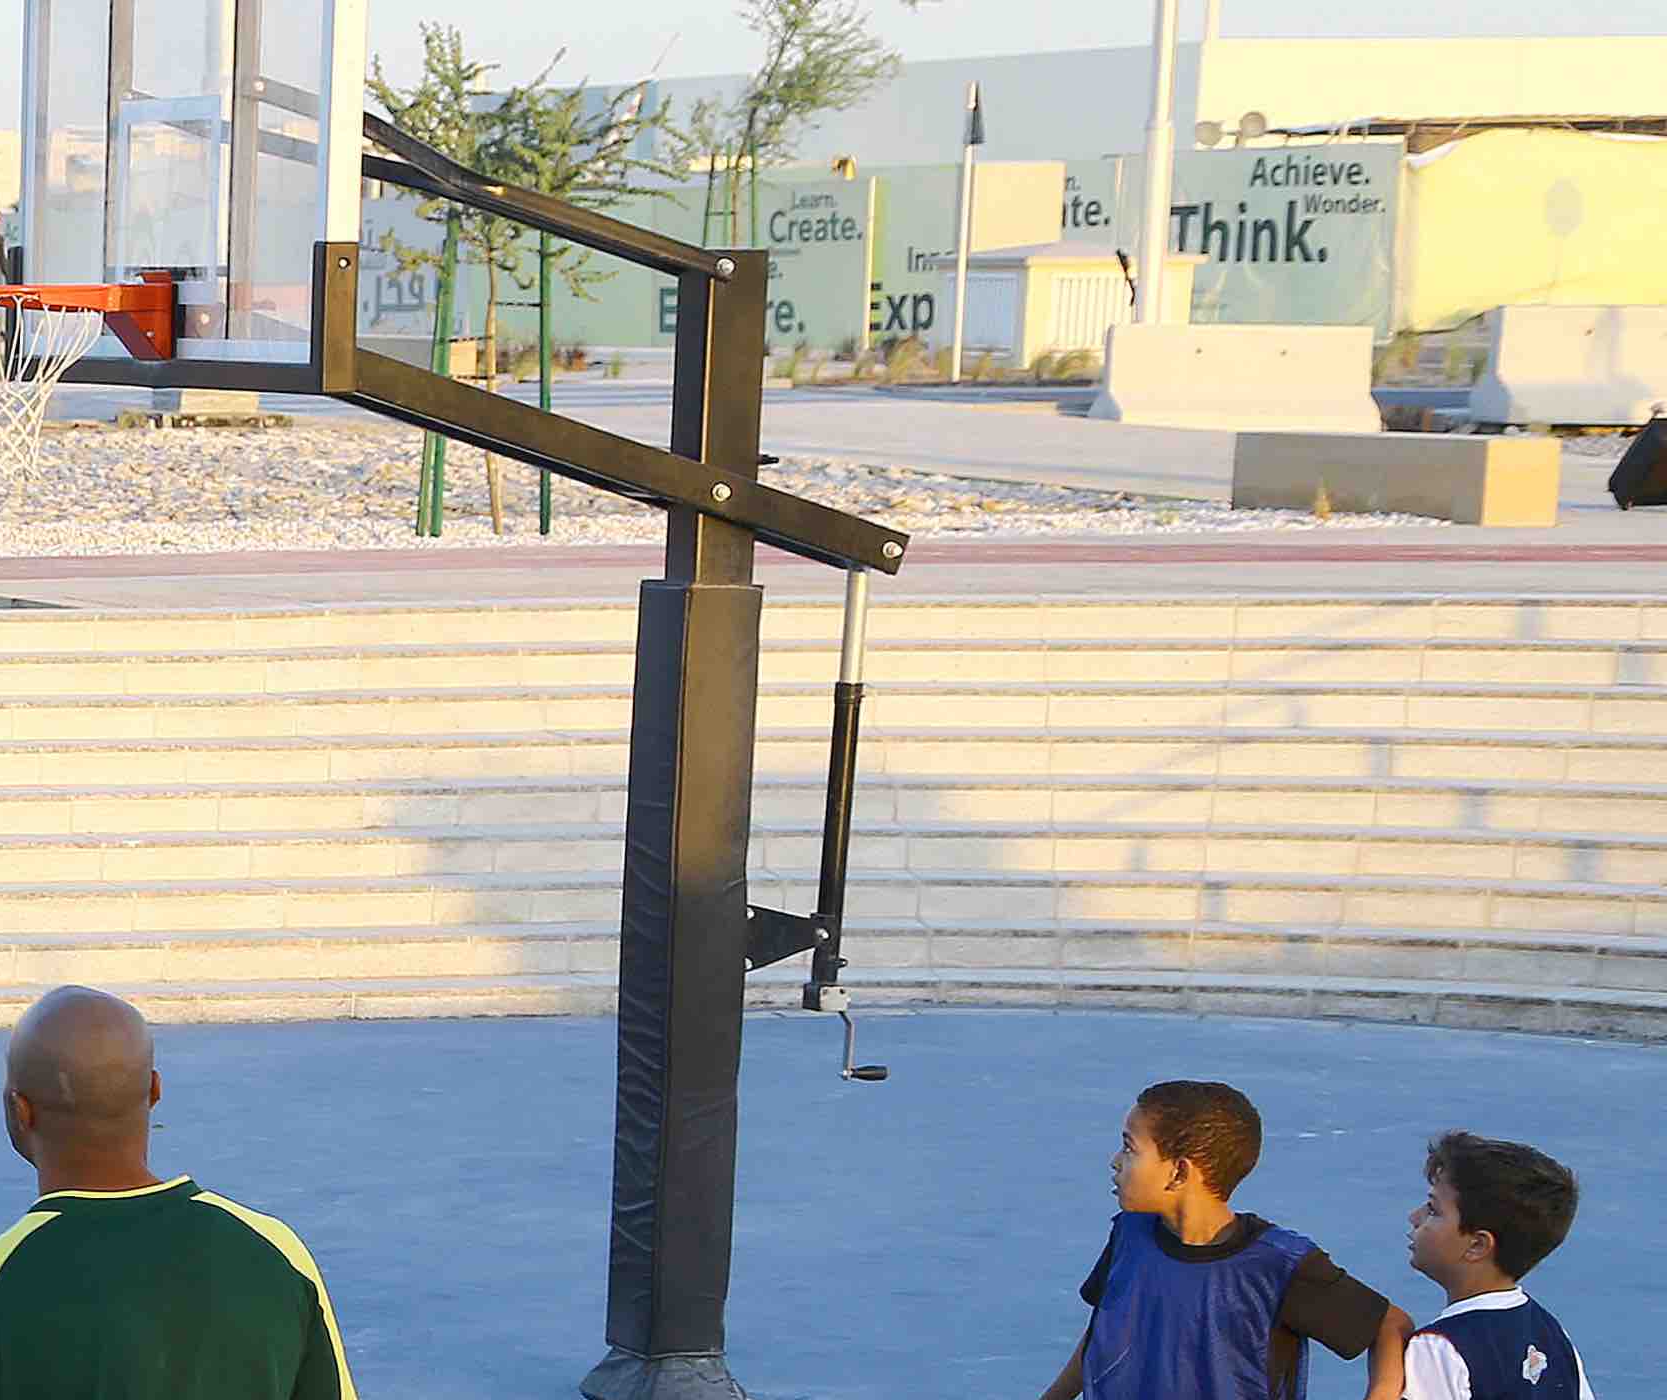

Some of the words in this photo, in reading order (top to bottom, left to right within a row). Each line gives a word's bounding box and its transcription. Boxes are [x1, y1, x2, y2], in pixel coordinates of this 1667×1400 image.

[1249, 155, 1370, 188] Achieve.
[1303, 193, 1387, 215] Wonder.
[769, 209, 864, 244] Create.
[1170, 201, 1329, 263] Think.
